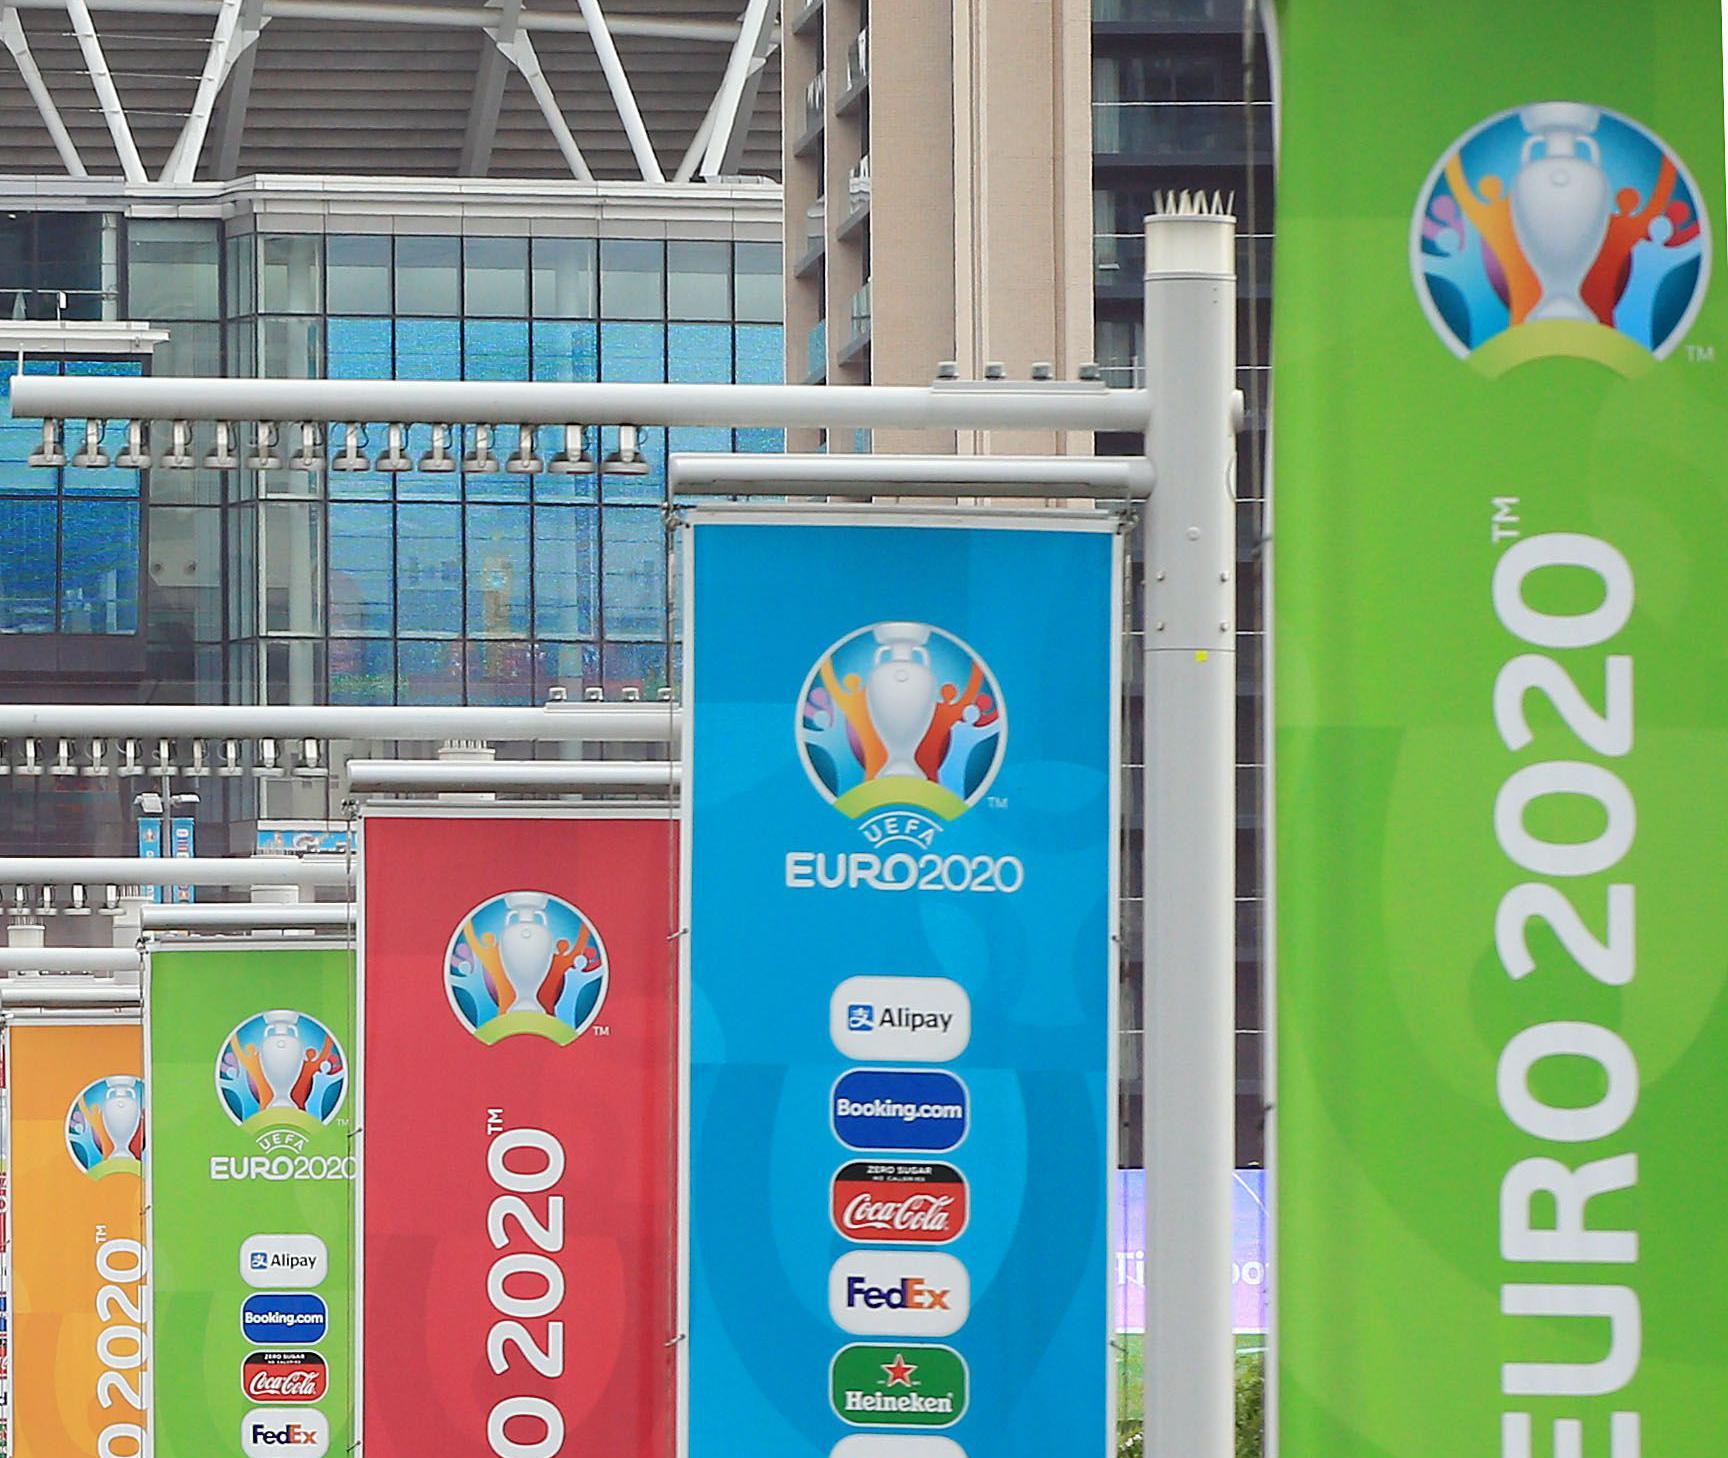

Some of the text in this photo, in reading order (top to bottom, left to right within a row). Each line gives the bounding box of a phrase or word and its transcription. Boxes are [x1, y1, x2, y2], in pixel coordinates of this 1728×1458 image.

[1493, 533, 1637, 987] 2020
[863, 815, 935, 847] UEFA
[785, 852, 1024, 893] EURO2020
[879, 1006, 953, 1033] Alipay
[836, 1098, 962, 1121] Booking.com
[258, 1132, 306, 1152] UEFA
[210, 1156, 357, 1181] EURO2020
[867, 1165, 932, 1174] ZERO SUGAR
[843, 1192, 949, 1232] Coca-Cola
[271, 1253, 317, 1271] Alipay
[486, 1128, 566, 1378] 2020
[847, 1276, 949, 1311] FedEx
[96, 1238, 149, 1410] 2020
[245, 1311, 324, 1327] Booking.com
[249, 1370, 316, 1395] Coca-Cola
[845, 1391, 950, 1413] Heineken
[252, 1424, 318, 1446] FedEx
